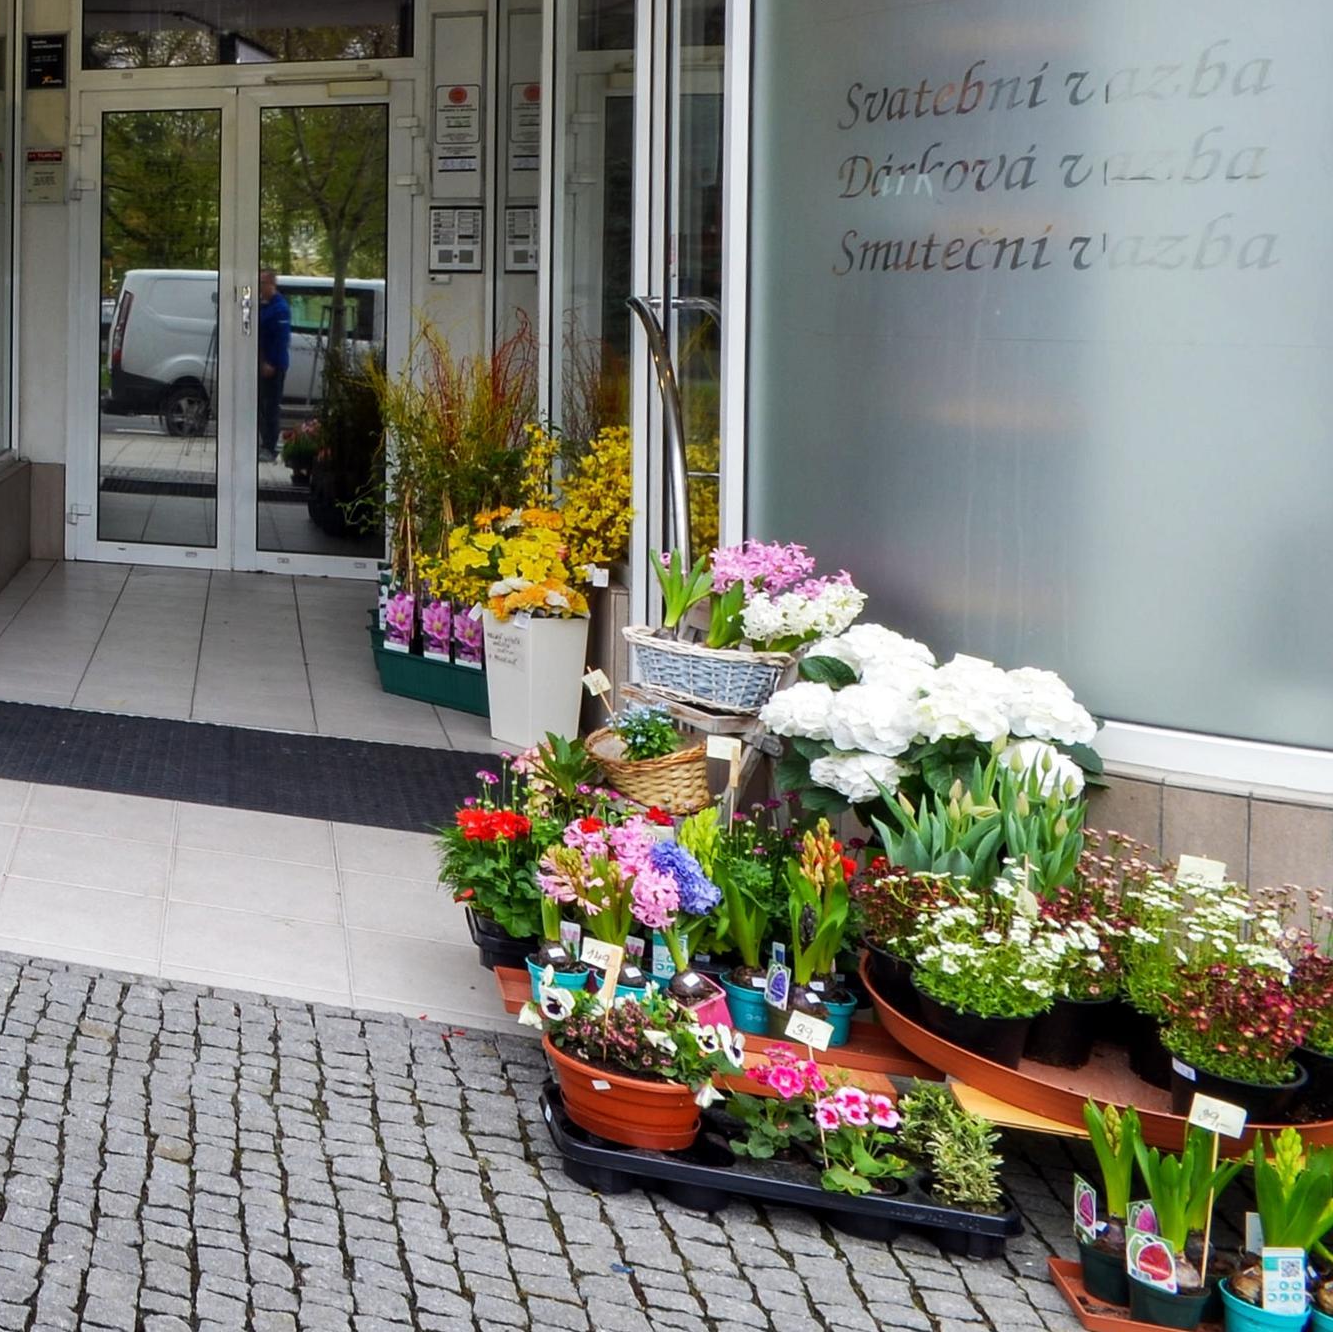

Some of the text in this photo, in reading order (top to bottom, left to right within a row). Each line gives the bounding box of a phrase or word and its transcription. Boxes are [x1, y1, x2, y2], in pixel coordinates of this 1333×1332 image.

[837, 59, 1049, 131] Svatební
[838, 142, 1037, 200] Dárková
[832, 224, 1054, 277] Smuteční
